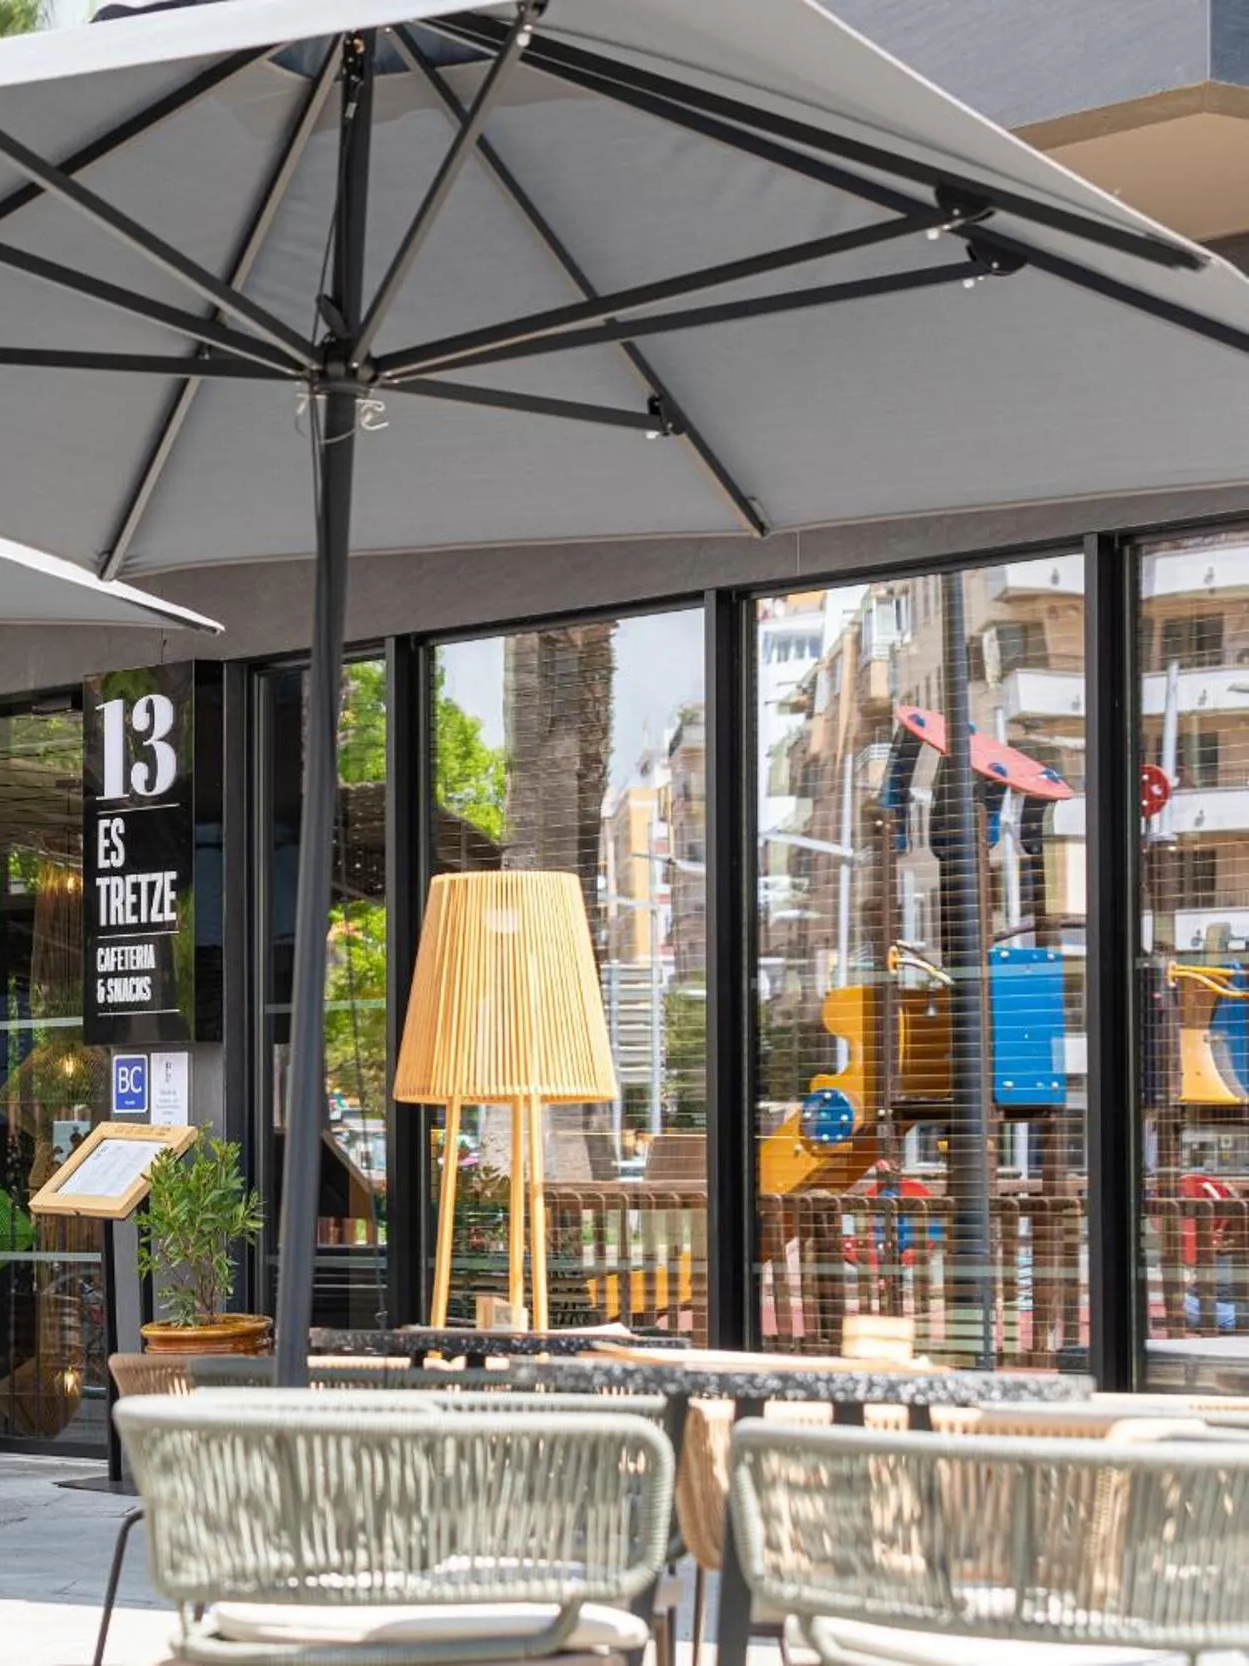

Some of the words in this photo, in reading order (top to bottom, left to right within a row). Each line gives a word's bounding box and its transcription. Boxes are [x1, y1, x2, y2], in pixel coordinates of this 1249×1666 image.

[95, 694, 177, 800] 13
[97, 817, 125, 869] ES
[96, 871, 177, 926] TRETZE
[97, 944, 156, 972] CAFETERIA
[118, 1066, 142, 1094] BC
